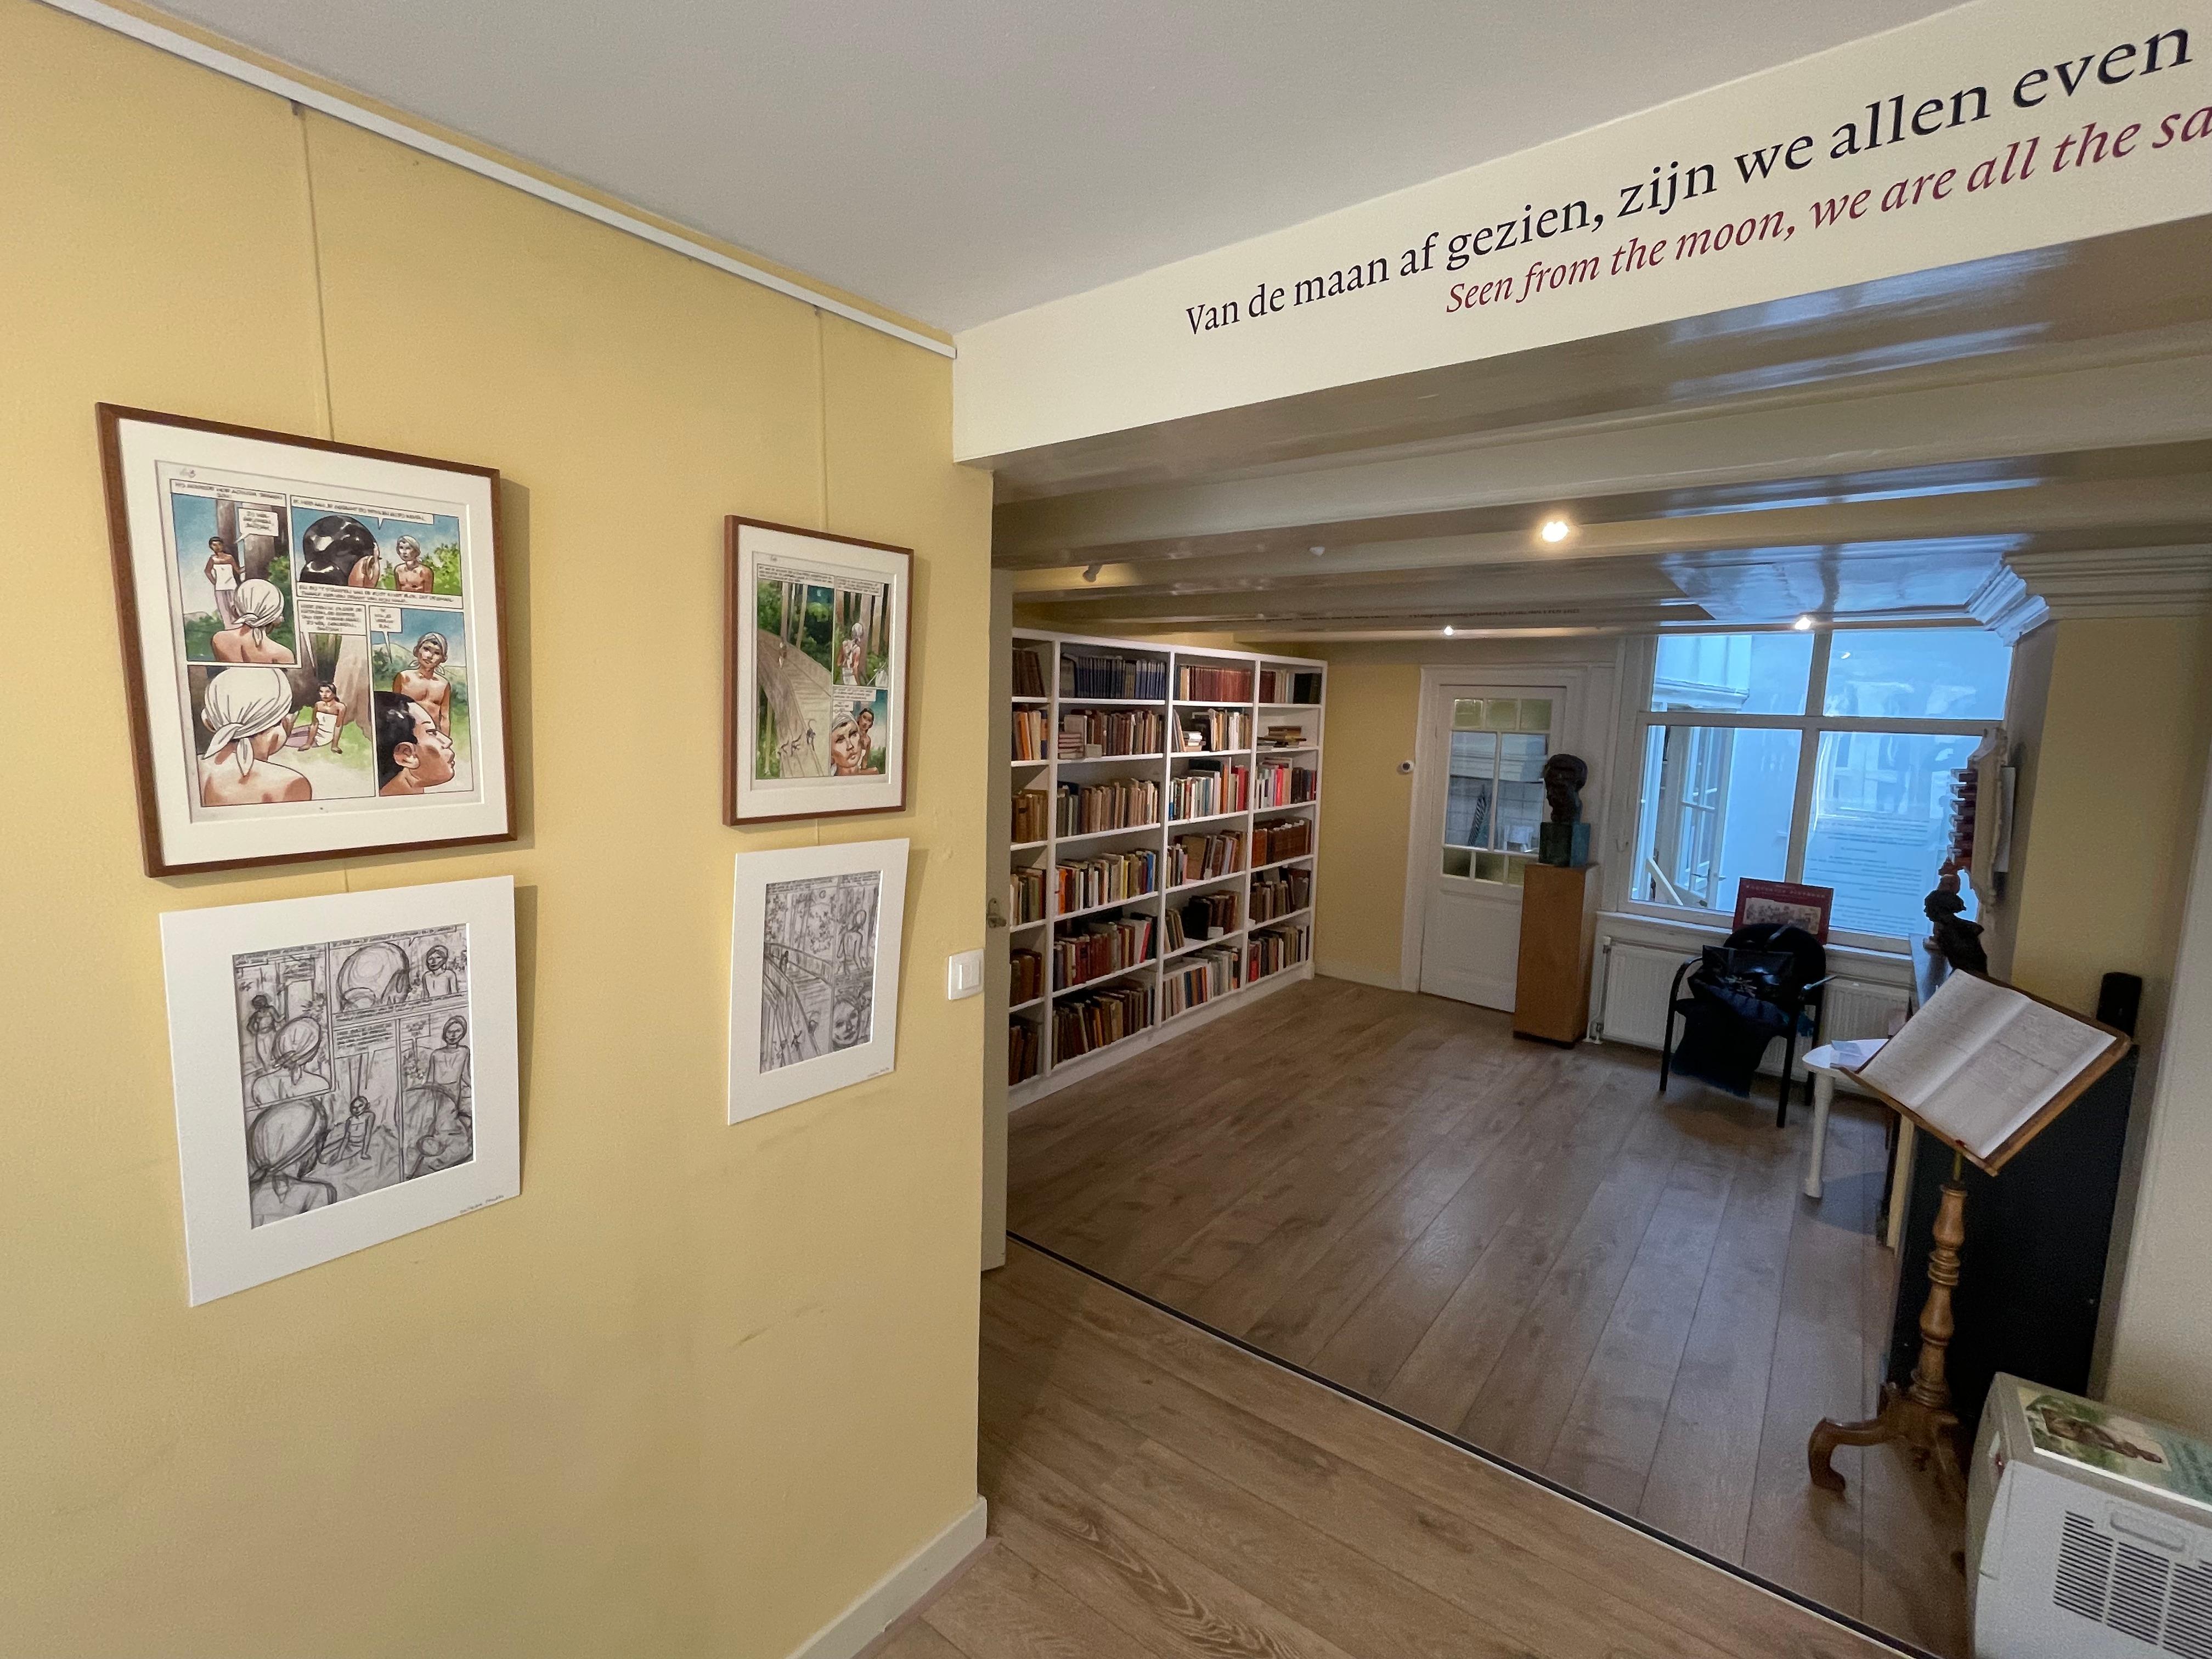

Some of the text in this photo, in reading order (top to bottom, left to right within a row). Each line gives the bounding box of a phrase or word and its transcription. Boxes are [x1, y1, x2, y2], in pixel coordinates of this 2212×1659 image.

[1185, 28, 2193, 335] Van de maan af gezien, zijn we allen even
[1446, 276, 1513, 313] Seen
[1515, 256, 1600, 304] from
[1611, 236, 1667, 276] the
[1675, 211, 1795, 261] moon,
[1808, 189, 1872, 229] we
[1881, 168, 1957, 212] are
[1967, 136, 2041, 193] all
[2052, 122, 2142, 173] the
